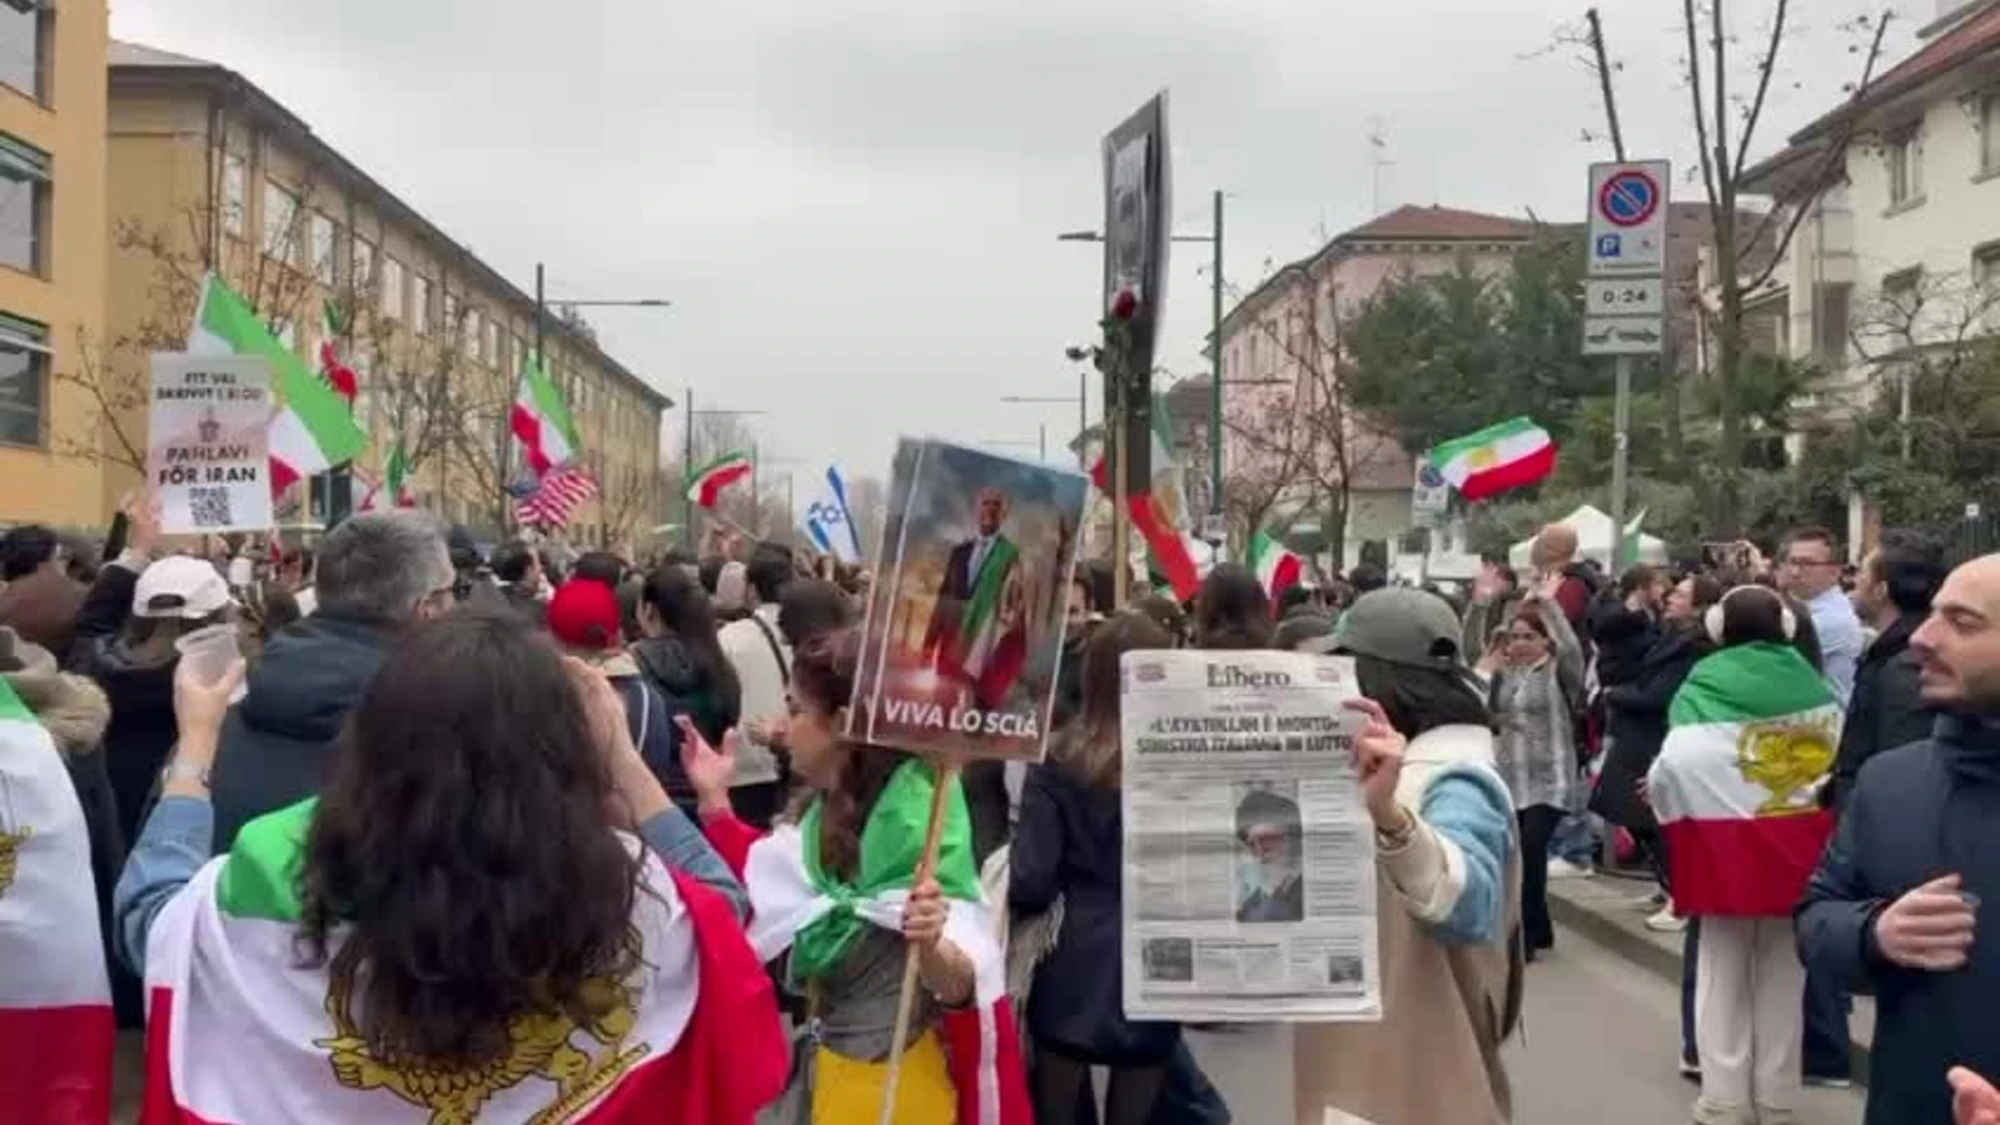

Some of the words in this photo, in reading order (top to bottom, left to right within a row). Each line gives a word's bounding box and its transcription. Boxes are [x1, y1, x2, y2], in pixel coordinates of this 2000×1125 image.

[166, 447, 249, 462] PAHLAVI
[159, 465, 199, 485] FÖR
[205, 467, 257, 483] IRAN
[1206, 662, 1291, 688] Libero
[883, 697, 944, 728] VIVA
[949, 708, 982, 733] LO
[983, 709, 1039, 739] SCIÀ
